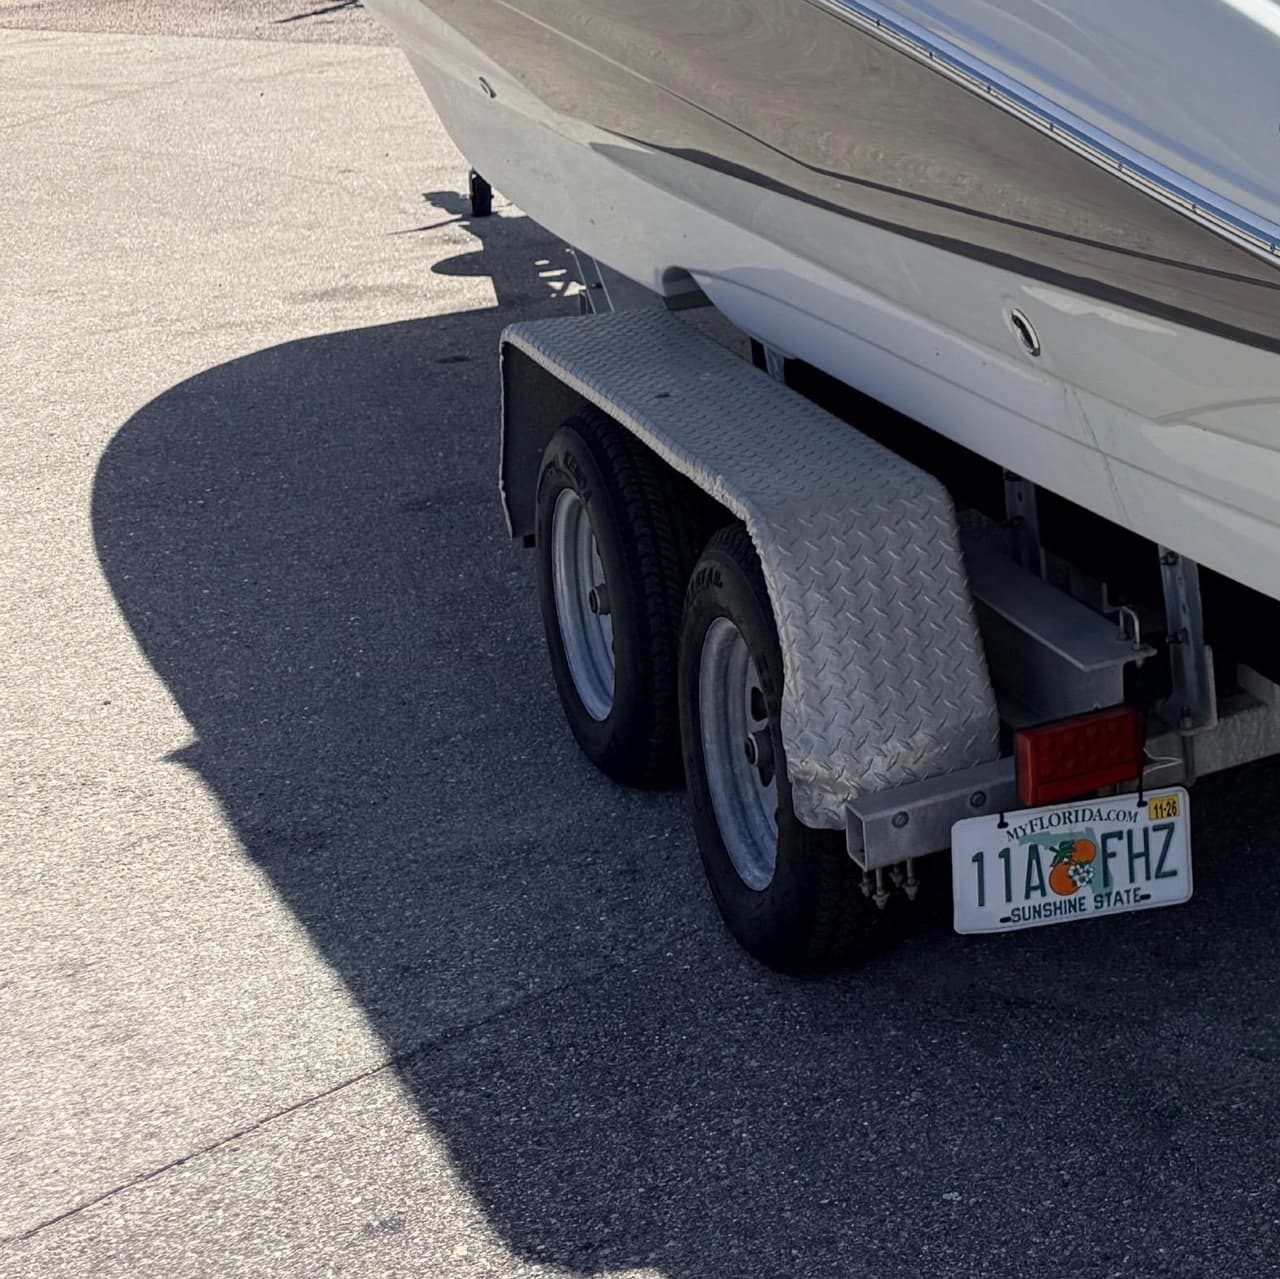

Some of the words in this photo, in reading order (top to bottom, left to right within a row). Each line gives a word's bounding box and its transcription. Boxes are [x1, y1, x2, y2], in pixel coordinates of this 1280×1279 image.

[1006, 806, 1139, 841] MYFLORIDA.COM
[971, 843, 1047, 907] 11A
[1101, 822, 1178, 888] FHZ
[1010, 895, 1087, 923] SUNSHINE
[1094, 887, 1142, 910] STATE
